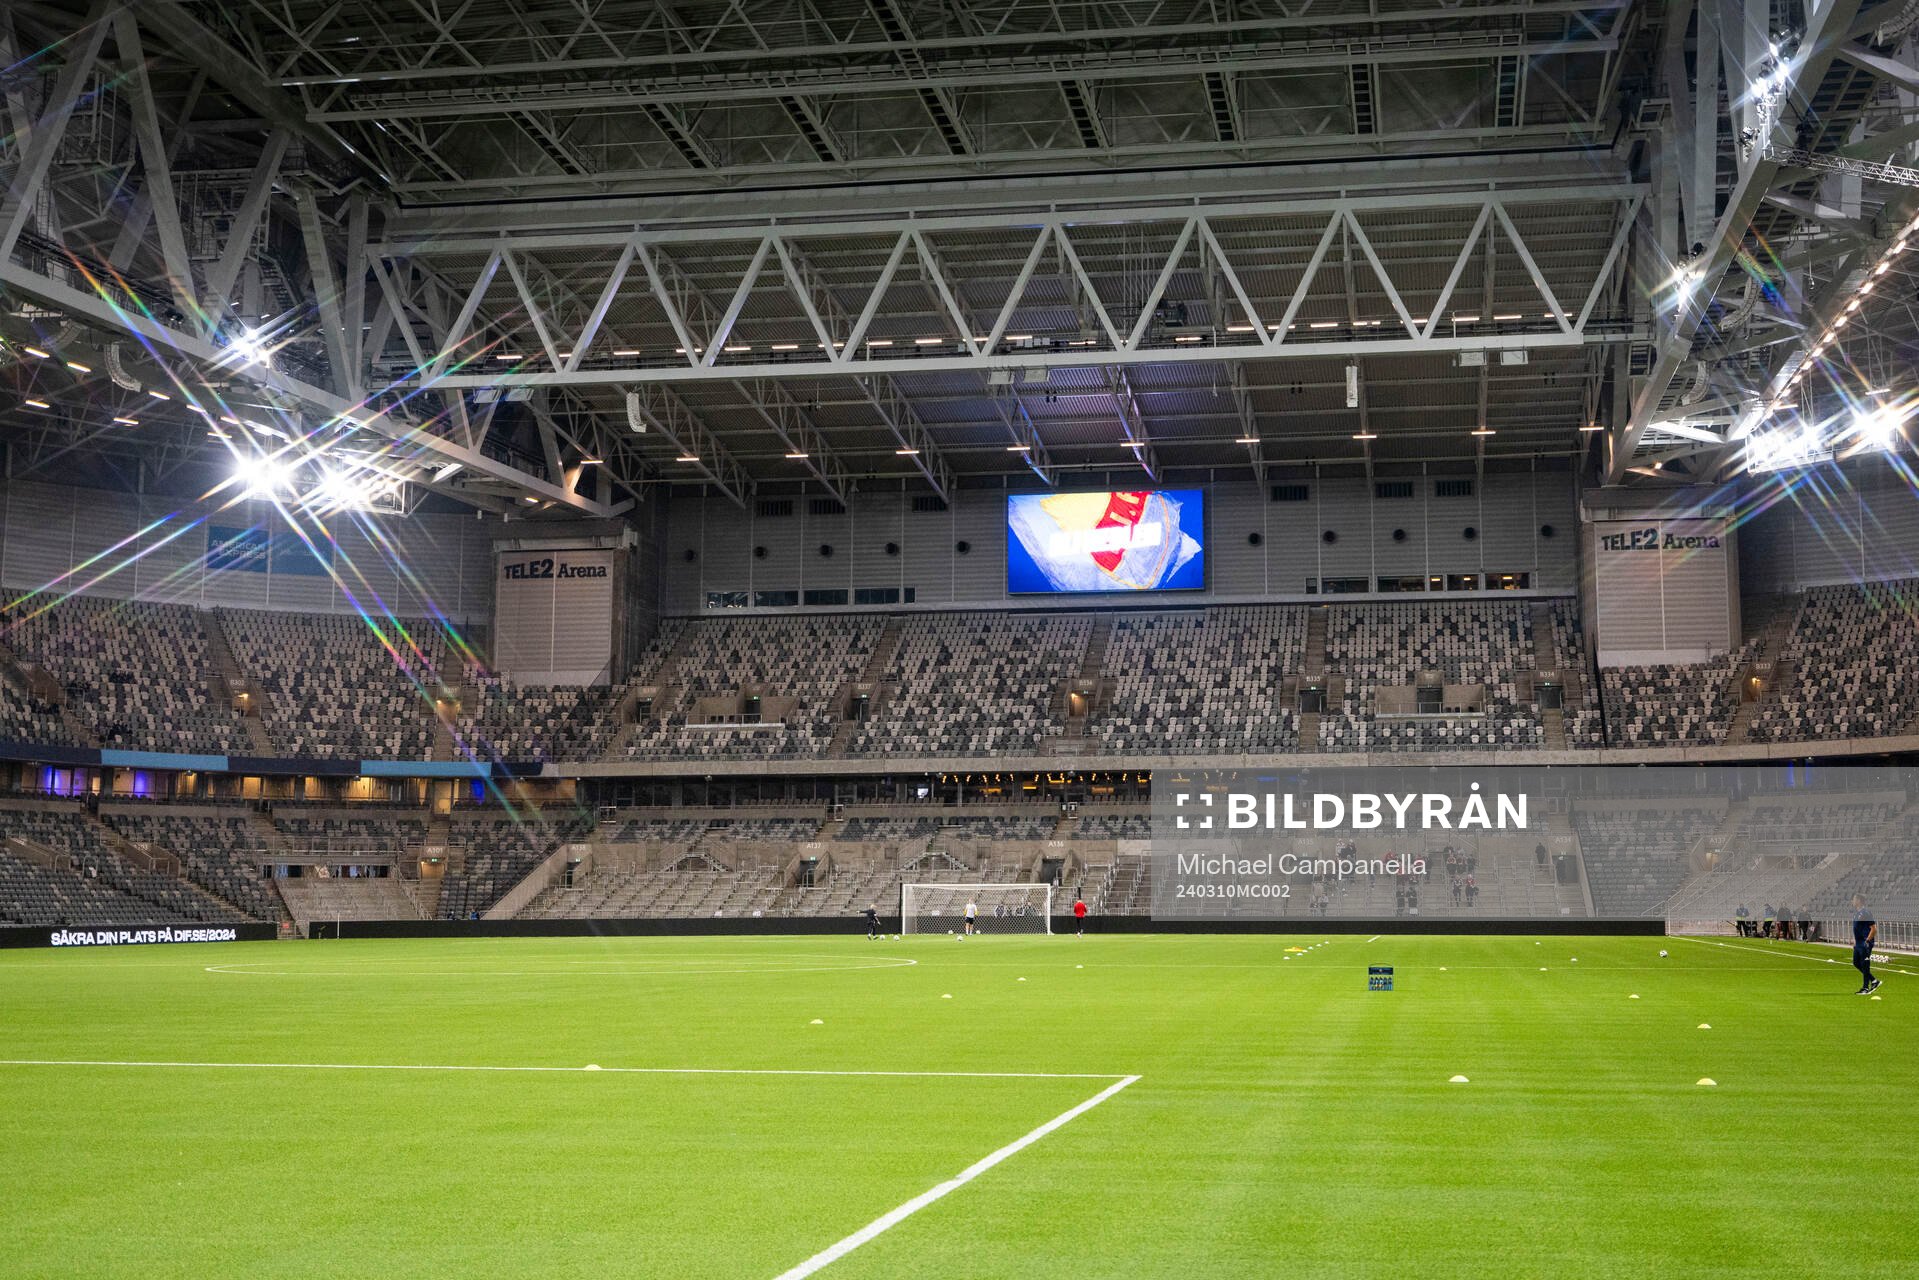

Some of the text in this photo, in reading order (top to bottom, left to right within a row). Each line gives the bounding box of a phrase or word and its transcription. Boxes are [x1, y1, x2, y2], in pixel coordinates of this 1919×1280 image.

[1601, 528, 1720, 551] TELE2 Arena
[504, 558, 607, 579] TELE2 Arena
[51, 927, 236, 946] SÄKRA DIN PLATS PÅ DIF.SE/2024
